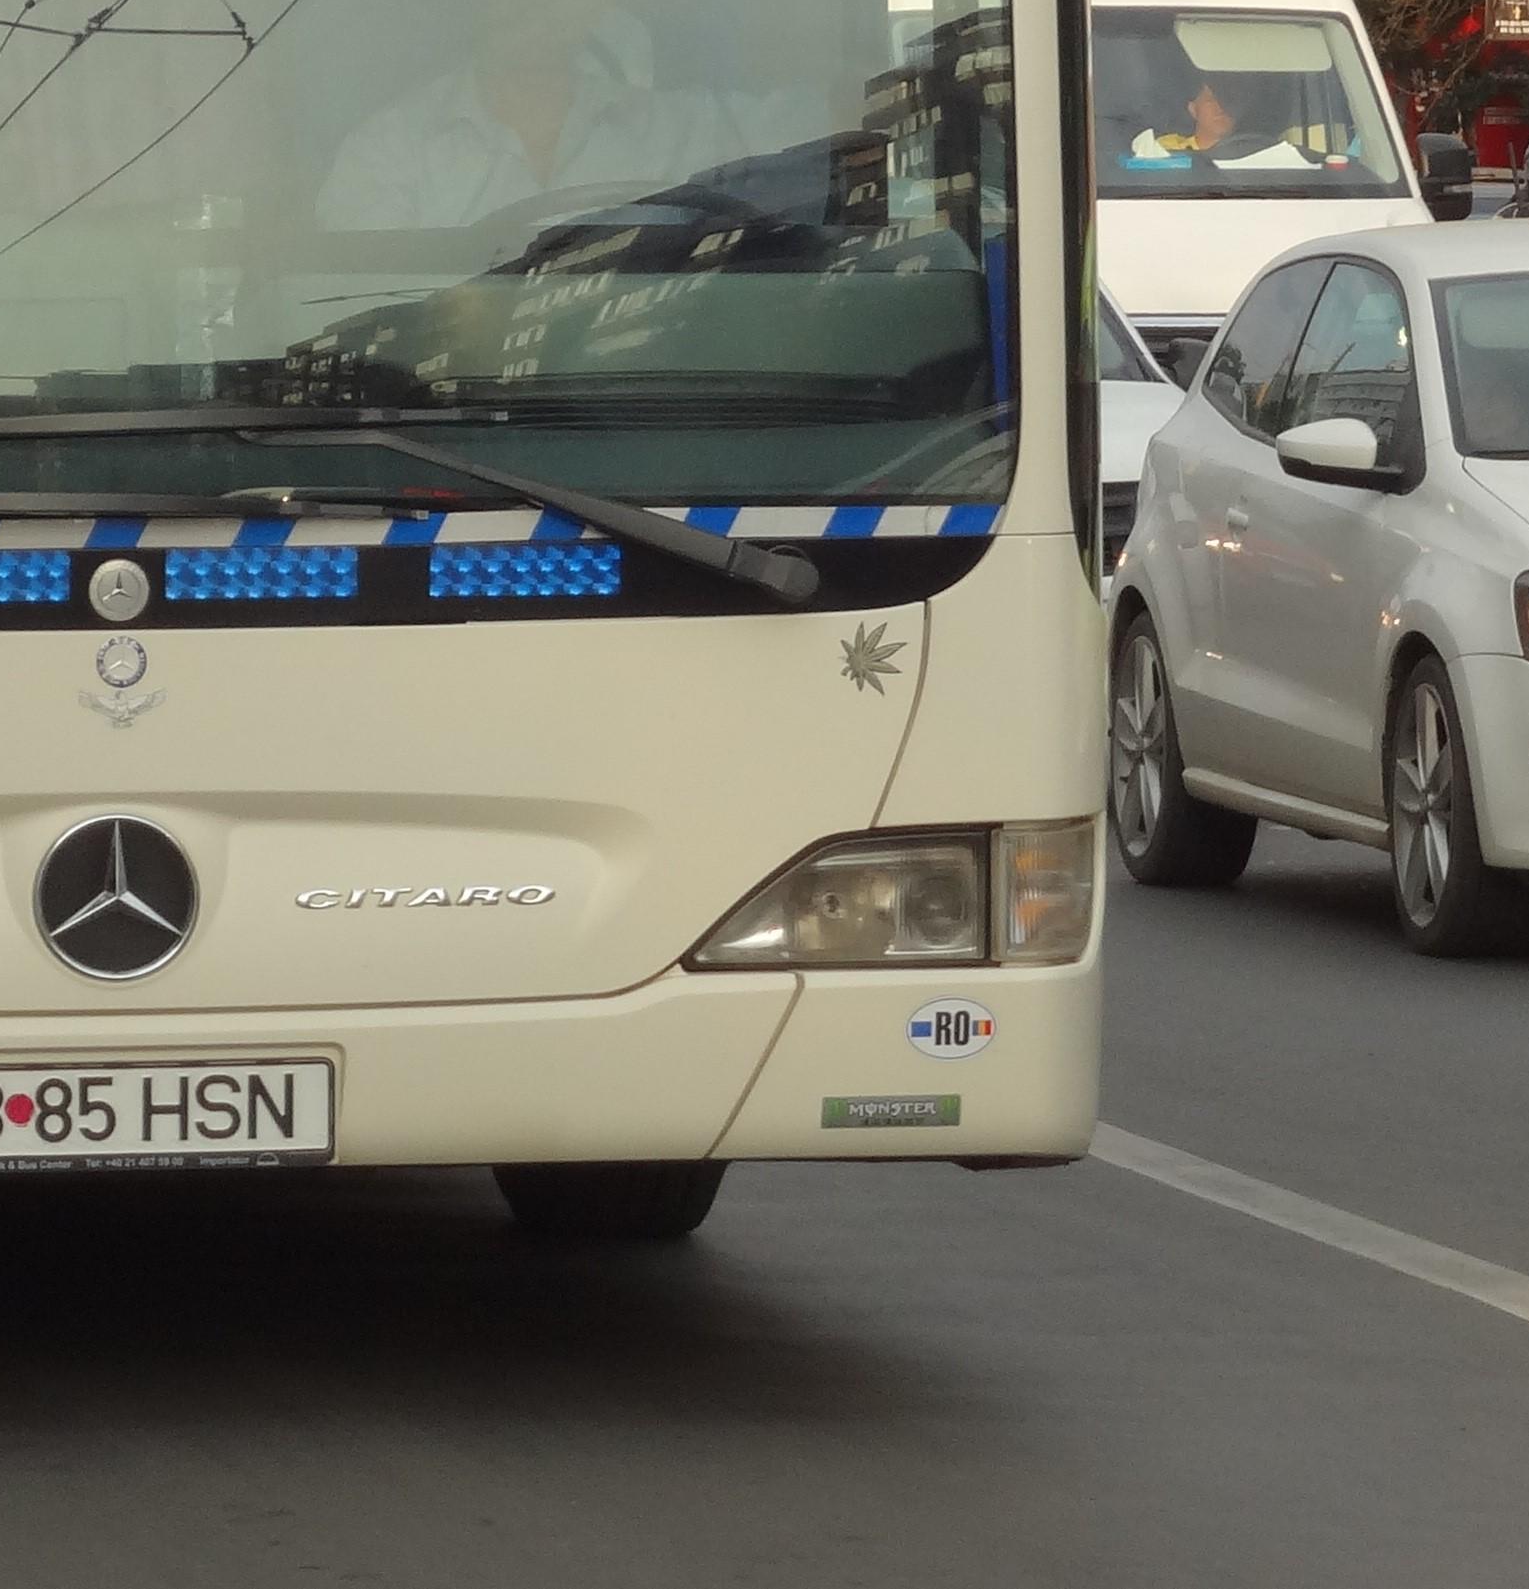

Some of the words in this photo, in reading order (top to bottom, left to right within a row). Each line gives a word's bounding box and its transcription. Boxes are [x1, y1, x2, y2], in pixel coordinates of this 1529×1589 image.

[295, 884, 556, 909] CITARO
[934, 1010, 971, 1046] RO
[34, 1077, 117, 1144] 85
[141, 1073, 295, 1143] HSN
